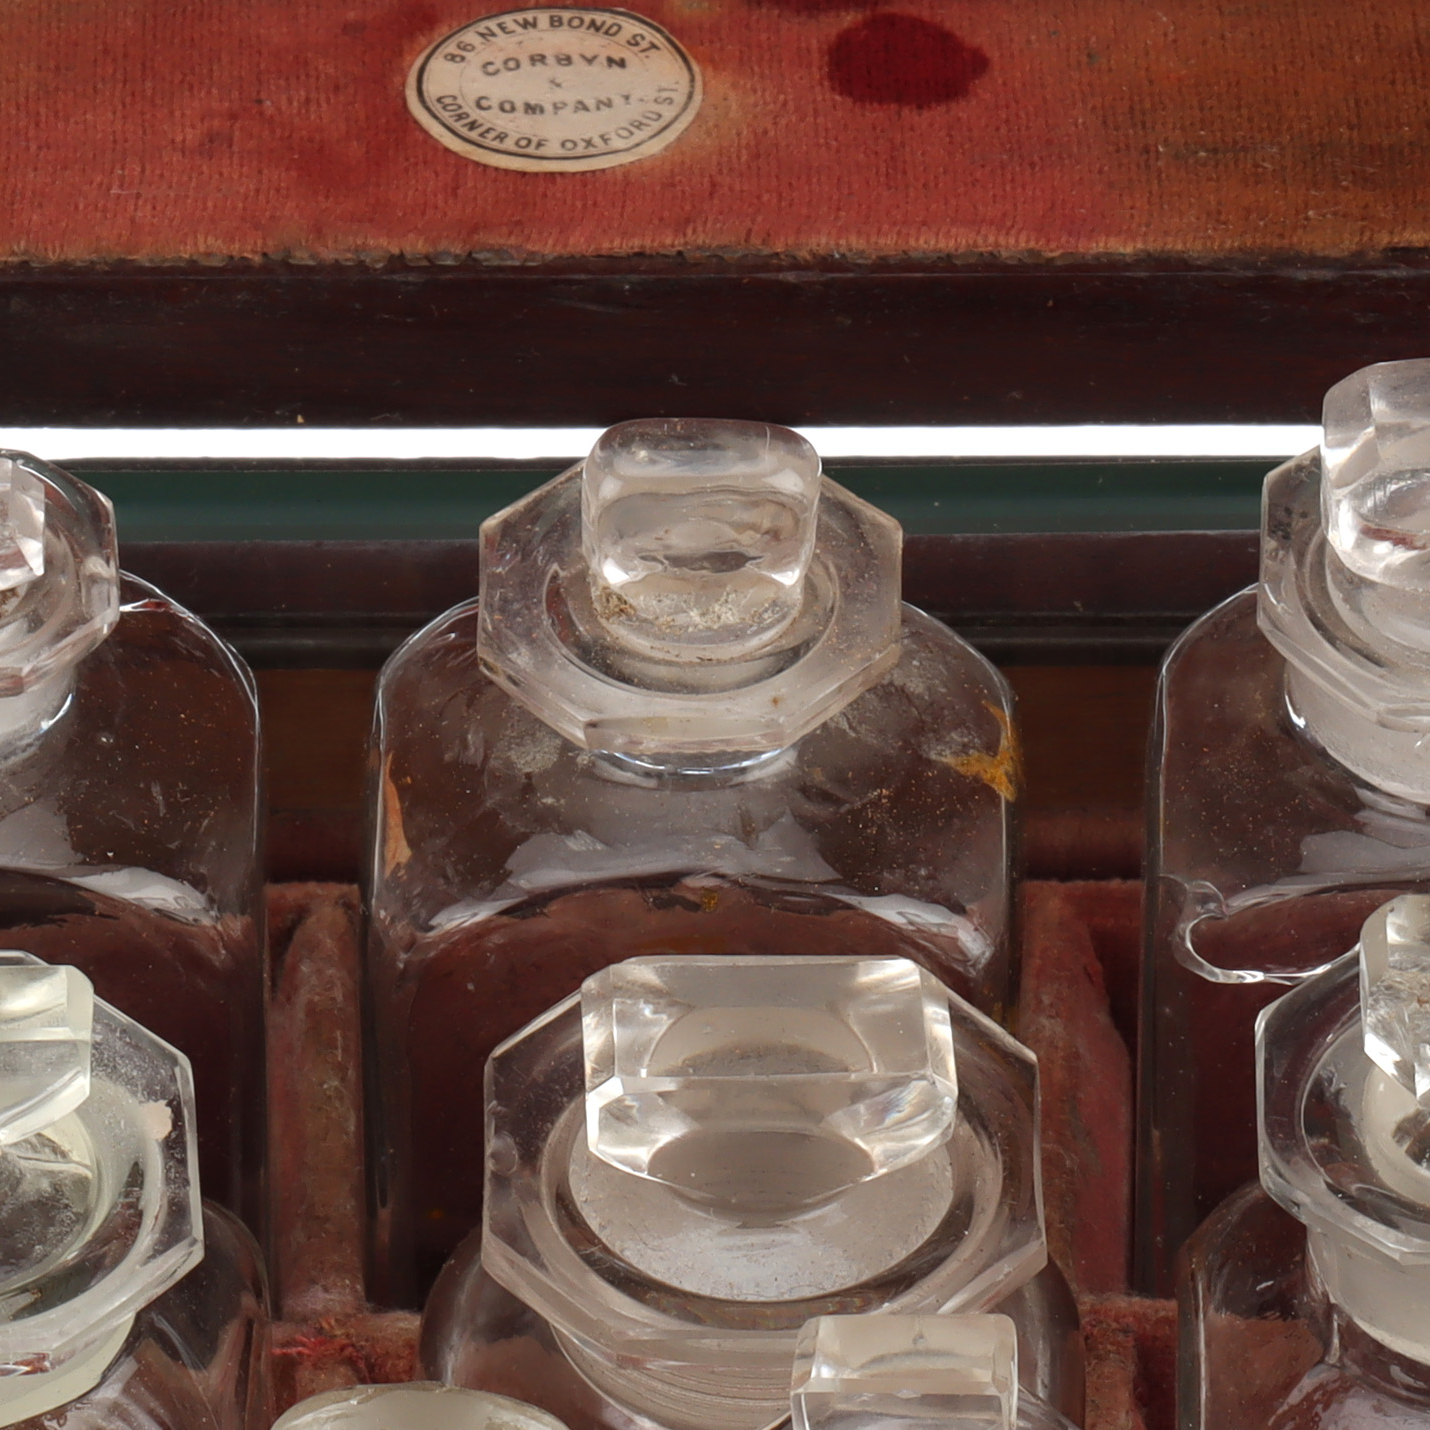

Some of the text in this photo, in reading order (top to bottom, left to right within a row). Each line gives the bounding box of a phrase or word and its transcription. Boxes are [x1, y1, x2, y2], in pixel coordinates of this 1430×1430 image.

[476, 15, 539, 44] NEW
[549, 15, 623, 38] BOND
[481, 53, 627, 76] CORBYN
[436, 94, 508, 144] CORNER
[514, 136, 549, 151] OF
[561, 110, 662, 151] OXFORD
